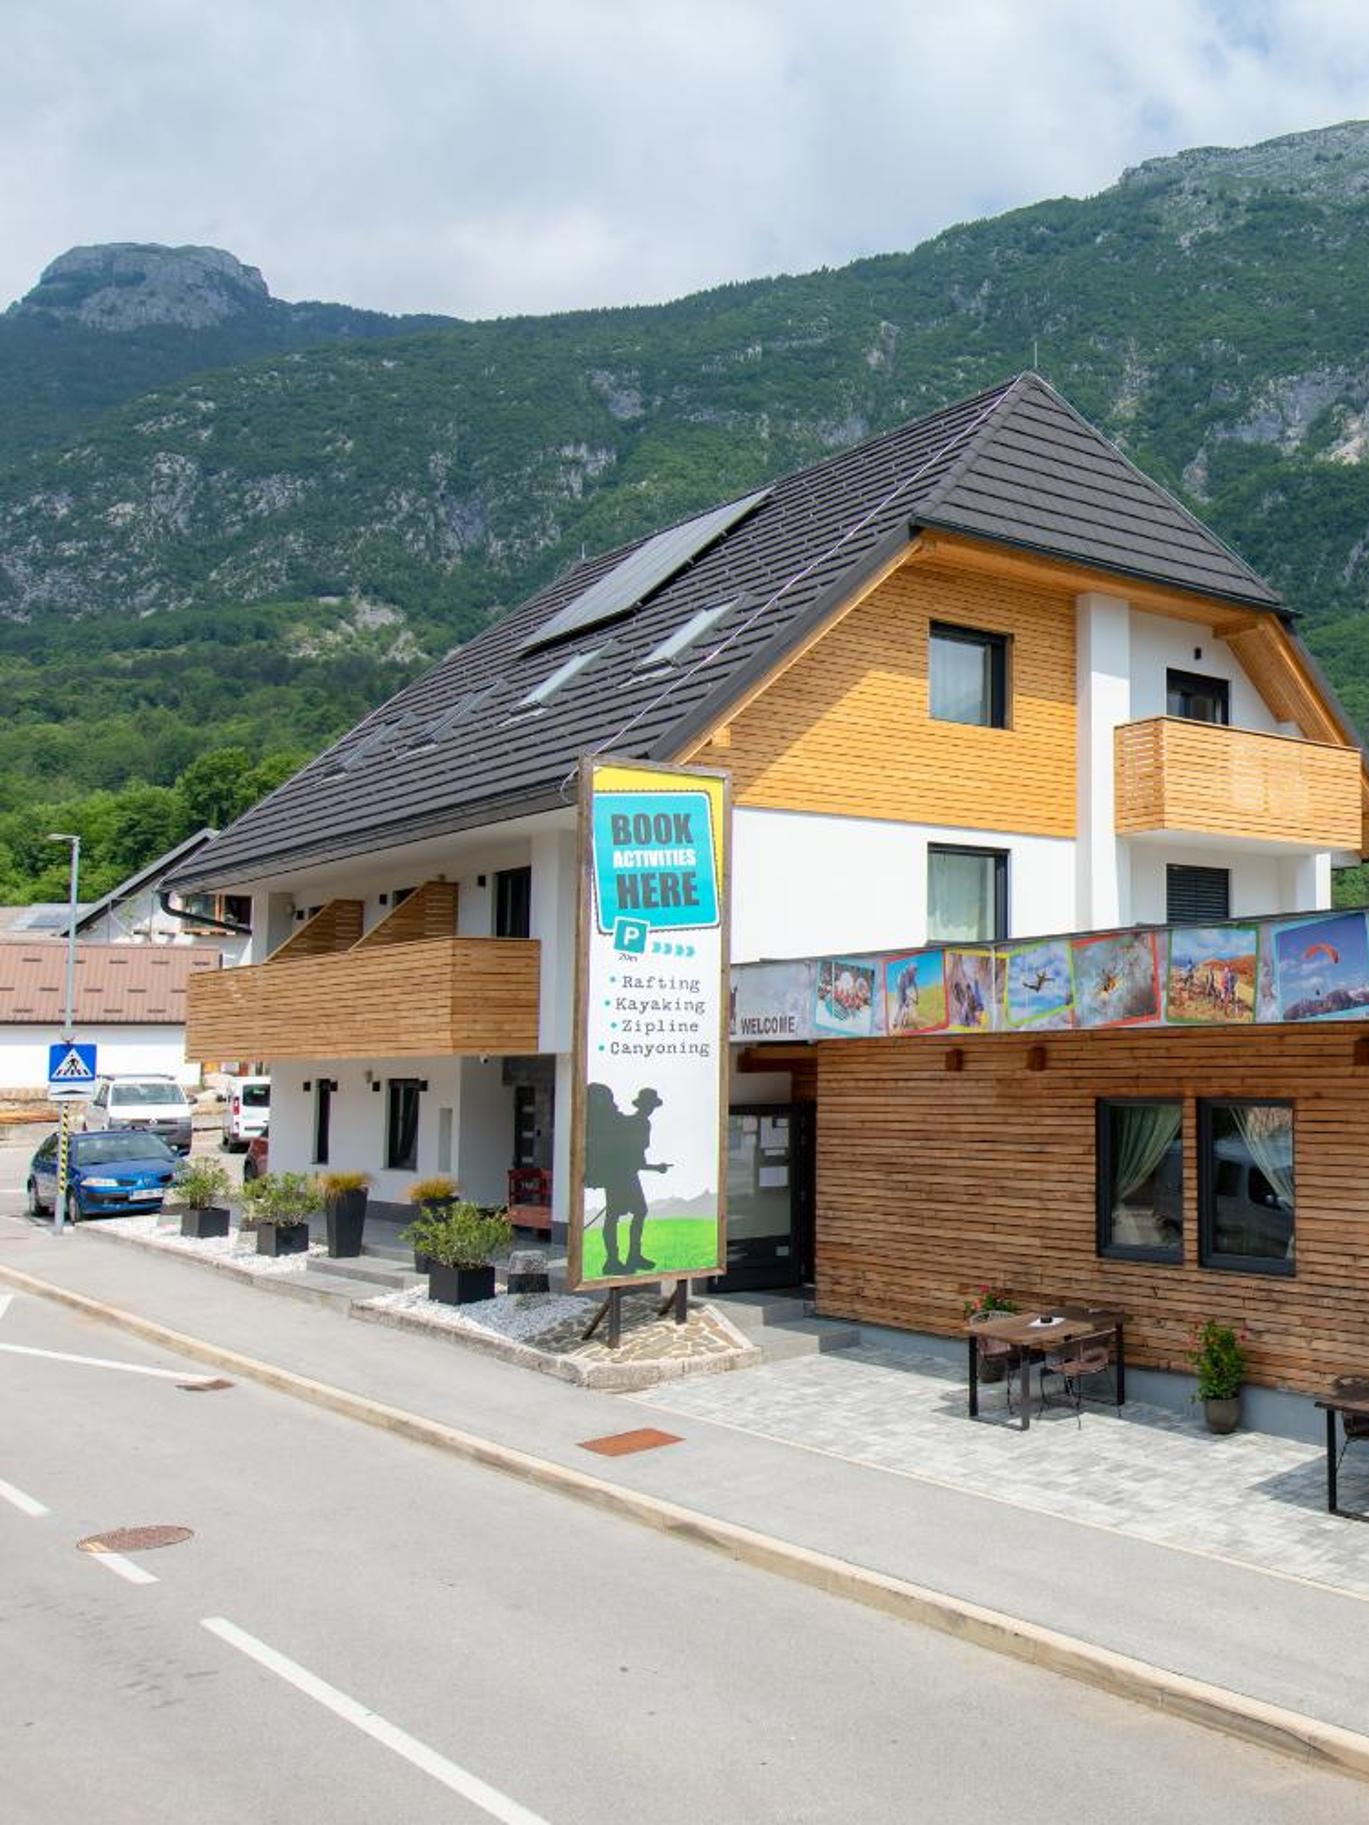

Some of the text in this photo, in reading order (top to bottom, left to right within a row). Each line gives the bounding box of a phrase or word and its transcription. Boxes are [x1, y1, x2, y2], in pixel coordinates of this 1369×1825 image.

[611, 813, 694, 845] BOOK
[613, 848, 697, 868] ACTIVITIES
[616, 871, 699, 909] HERE
[624, 926, 640, 946] P
[622, 975, 700, 993] Rafting
[615, 998, 706, 1015] Kayaking
[621, 1020, 699, 1036] Zipline
[741, 1016, 796, 1035] WELCOME
[610, 1041, 711, 1058] Canyoning
